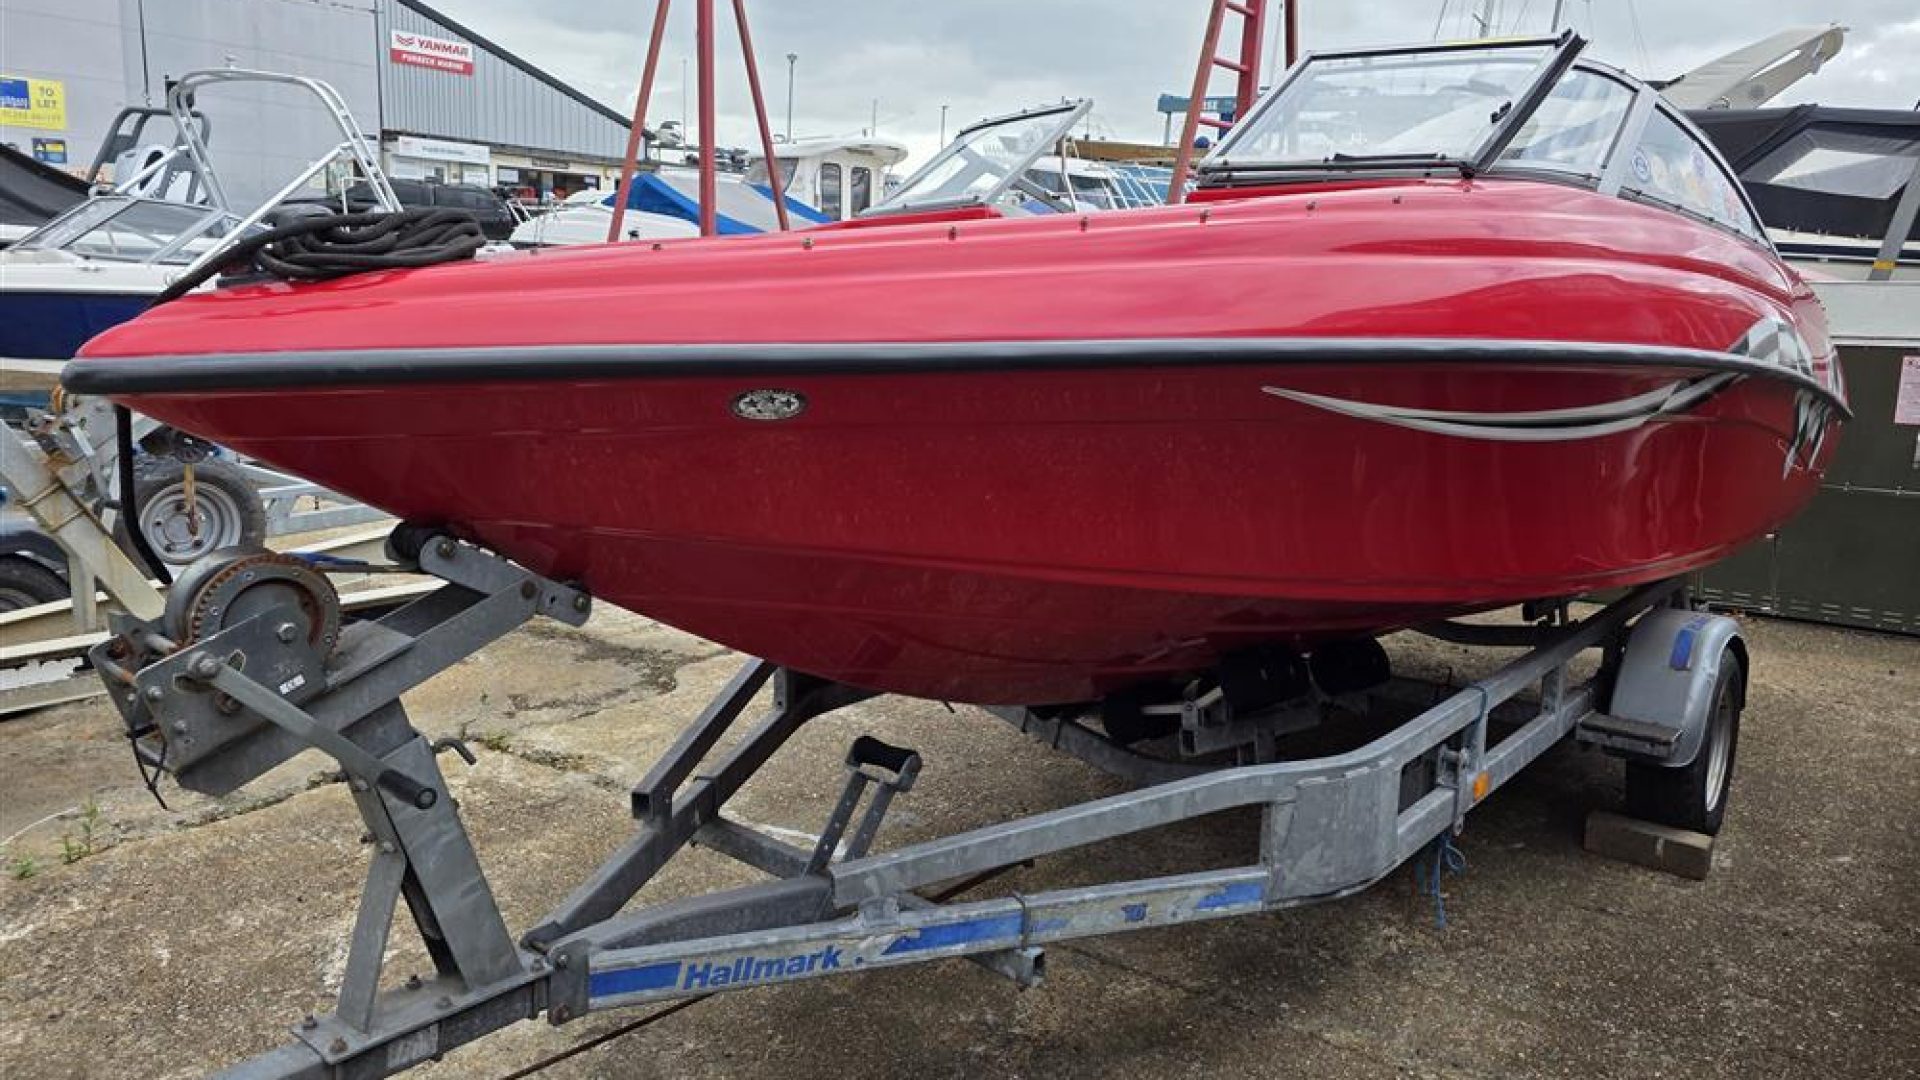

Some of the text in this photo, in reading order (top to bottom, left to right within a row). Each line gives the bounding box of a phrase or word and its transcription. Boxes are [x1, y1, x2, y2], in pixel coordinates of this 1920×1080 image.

[418, 39, 469, 55] YANMAR
[38, 86, 55, 97] TO
[37, 99, 57, 109] LET
[683, 944, 843, 990] Hallmark
